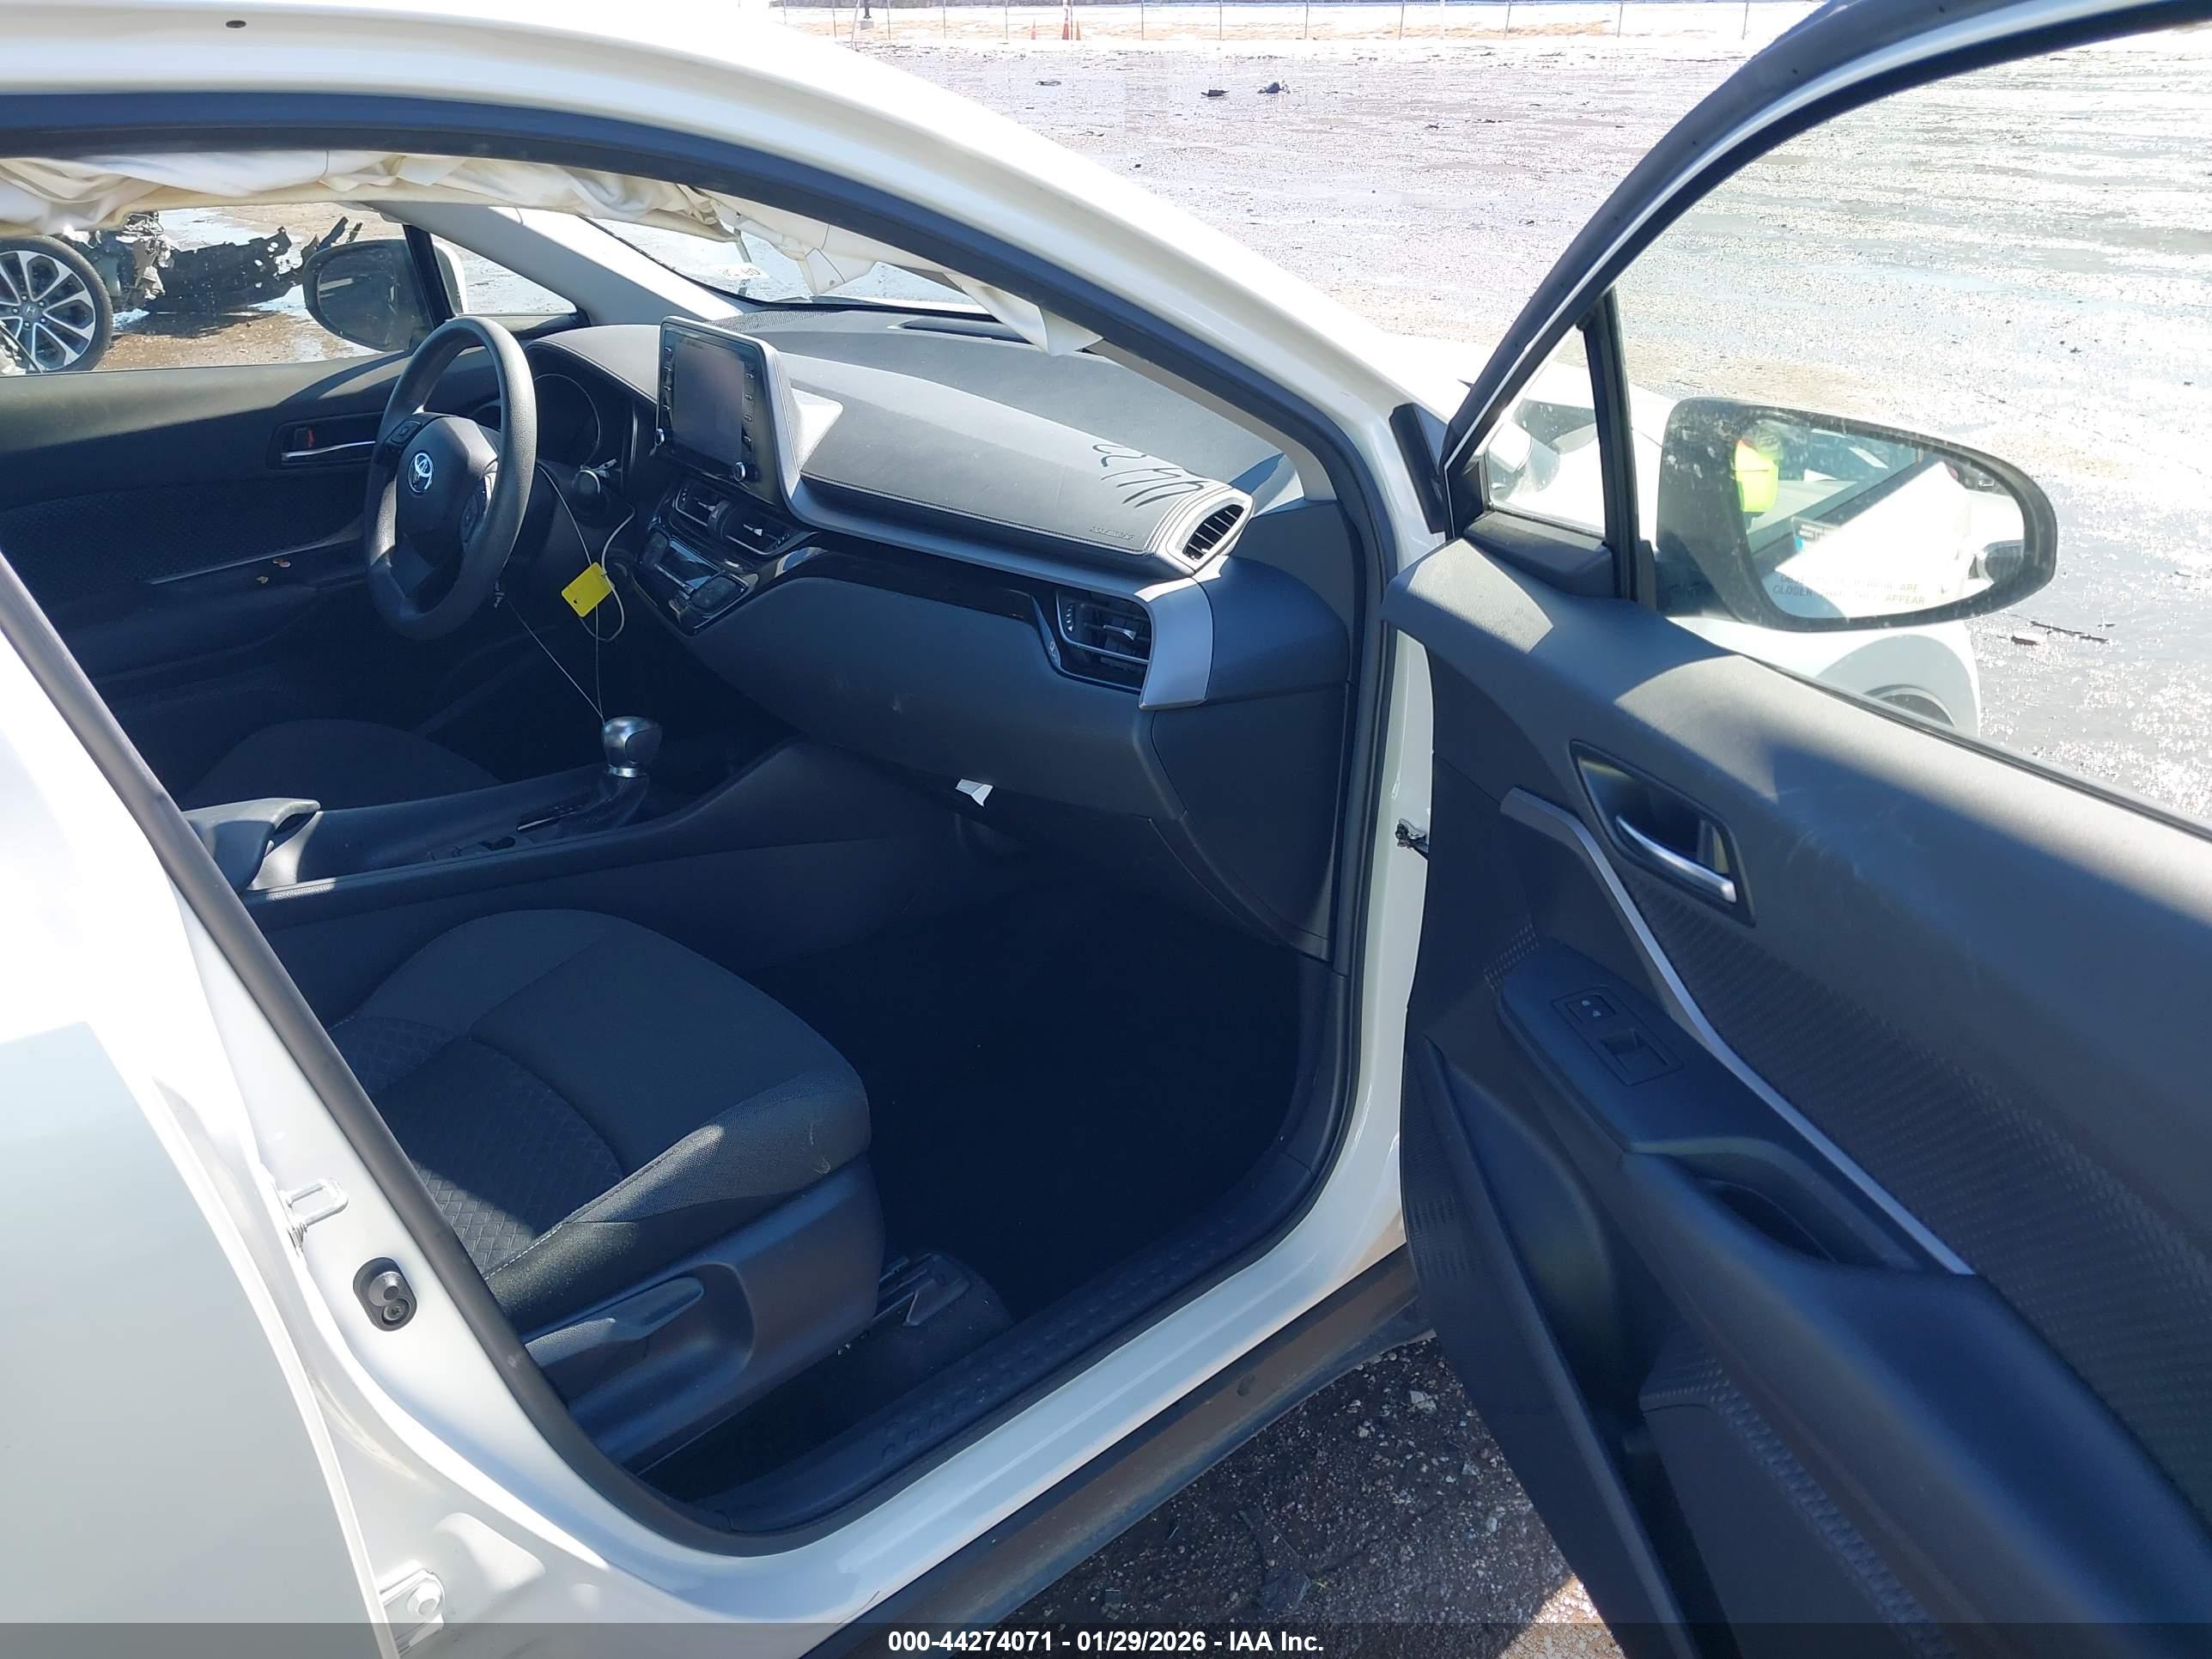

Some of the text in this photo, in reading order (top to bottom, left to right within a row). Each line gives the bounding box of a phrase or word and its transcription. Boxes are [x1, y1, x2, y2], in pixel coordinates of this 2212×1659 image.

[1773, 584, 1814, 598] CLOSER
[1885, 593, 1926, 605] APPEAR
[1899, 583, 1919, 593] ARE
